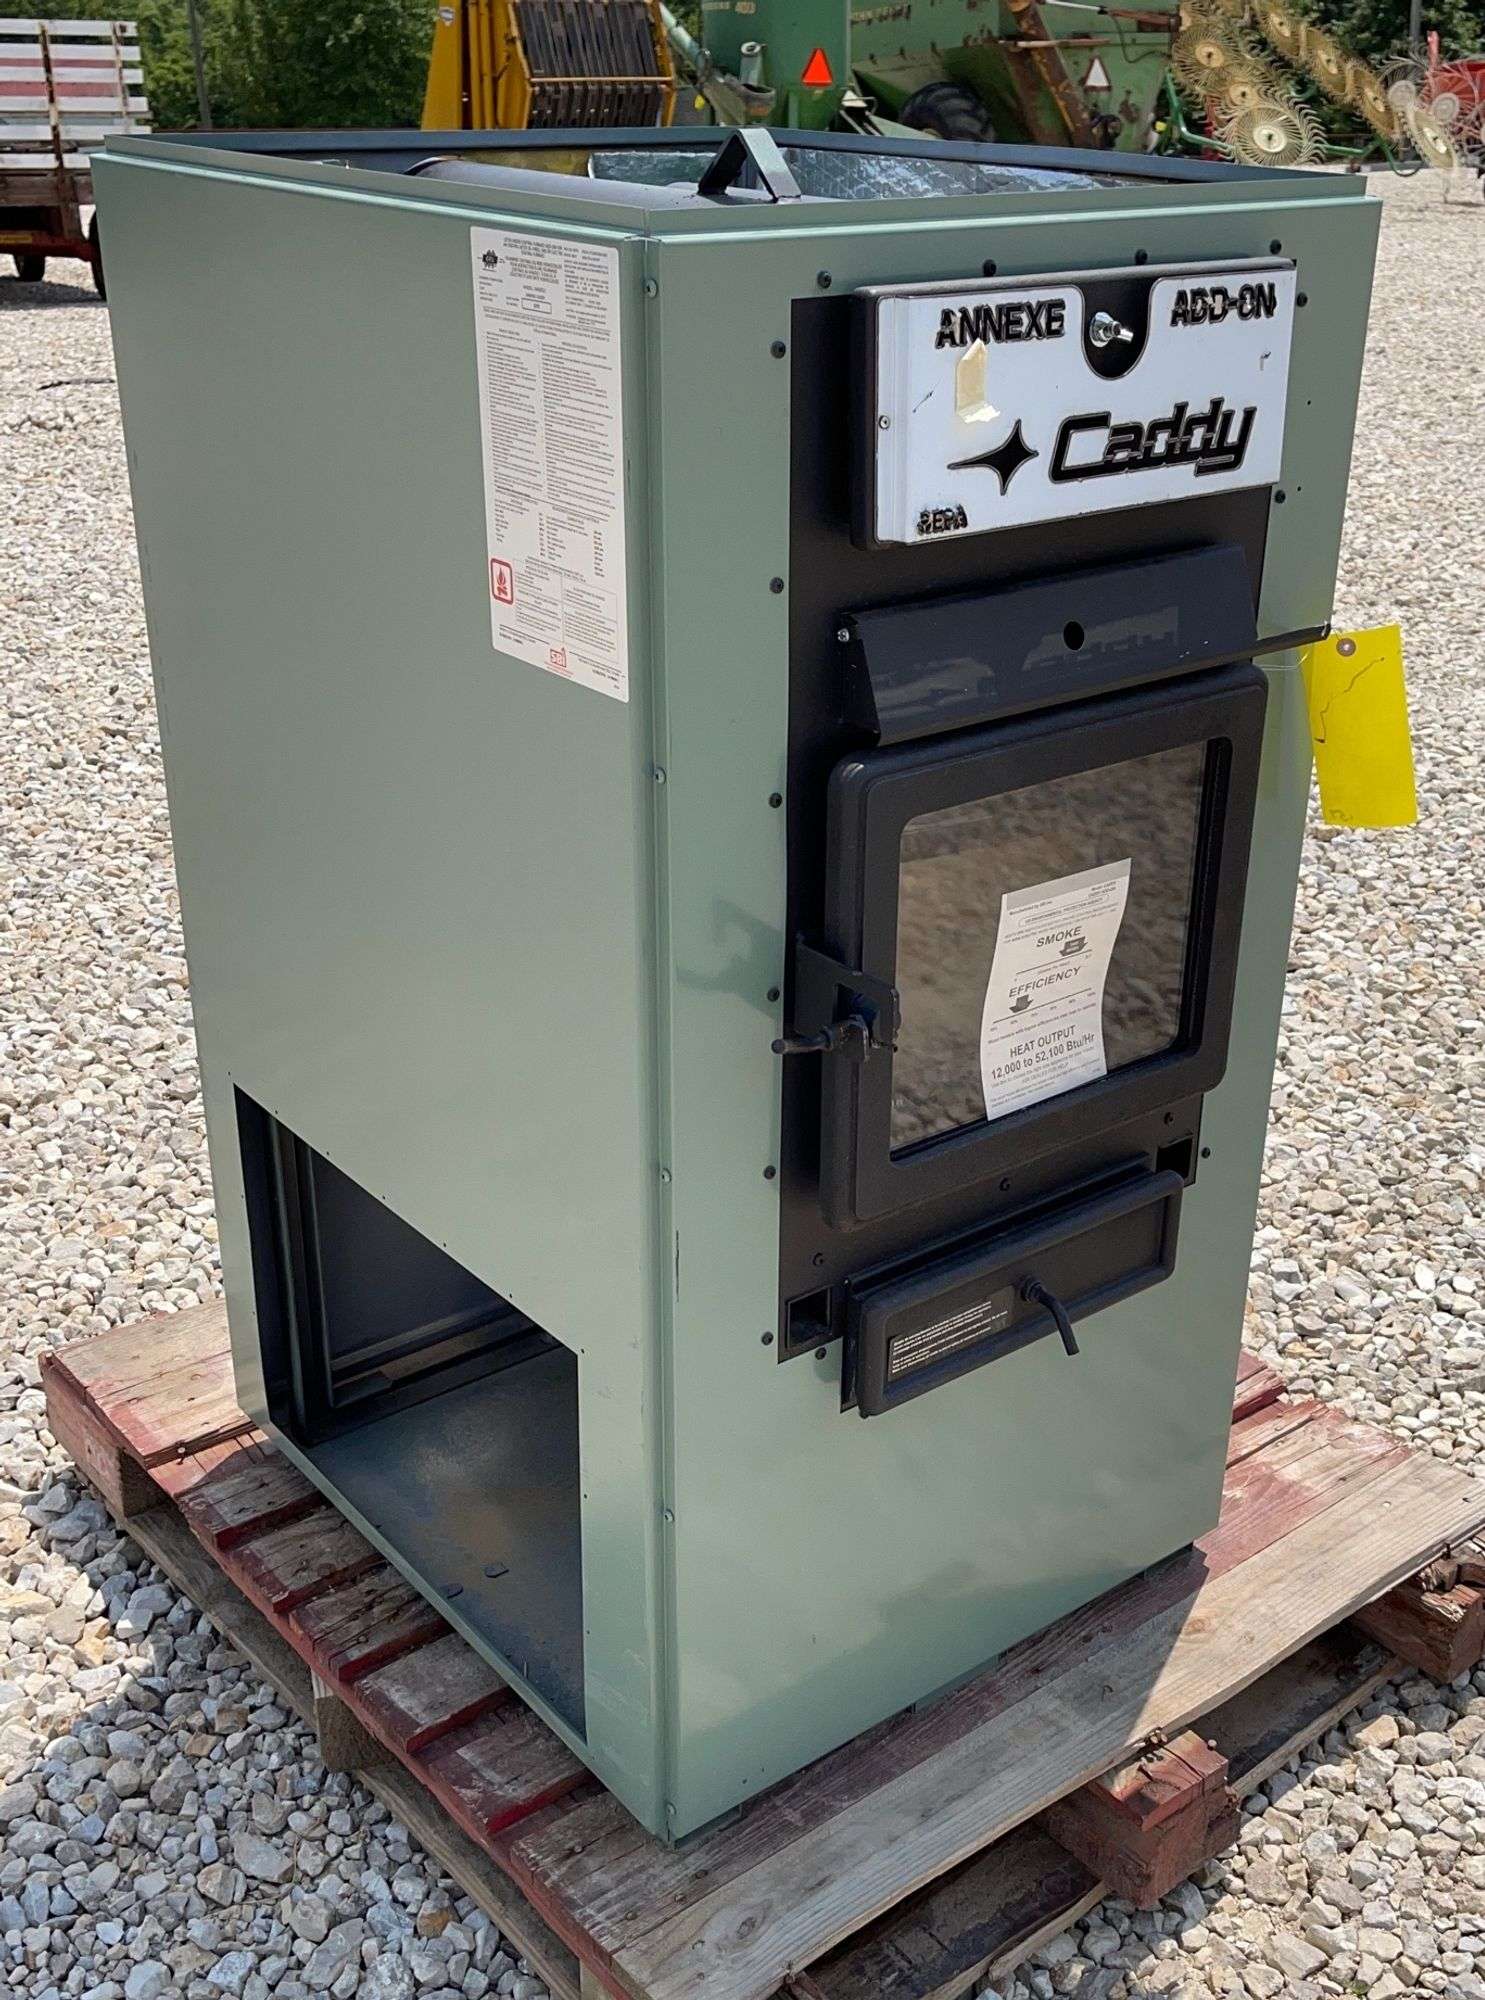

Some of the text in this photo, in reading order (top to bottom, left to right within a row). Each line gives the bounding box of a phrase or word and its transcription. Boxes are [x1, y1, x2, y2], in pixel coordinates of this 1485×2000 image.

[935, 299, 1066, 349] ANNEXE
[1170, 282, 1278, 326] ADD-ON
[1049, 397, 1257, 484] Caddy
[1036, 927, 1083, 948] SMOKE
[1008, 966, 1082, 998] EFFICIENCY
[991, 1059, 1022, 1080] 12,000
[1023, 1057, 1034, 1068] to
[1035, 1043, 1065, 1064] 52,100
[1066, 1032, 1096, 1052] Btu/Hr
[1010, 1025, 1077, 1058] HEAT OUTPUT
